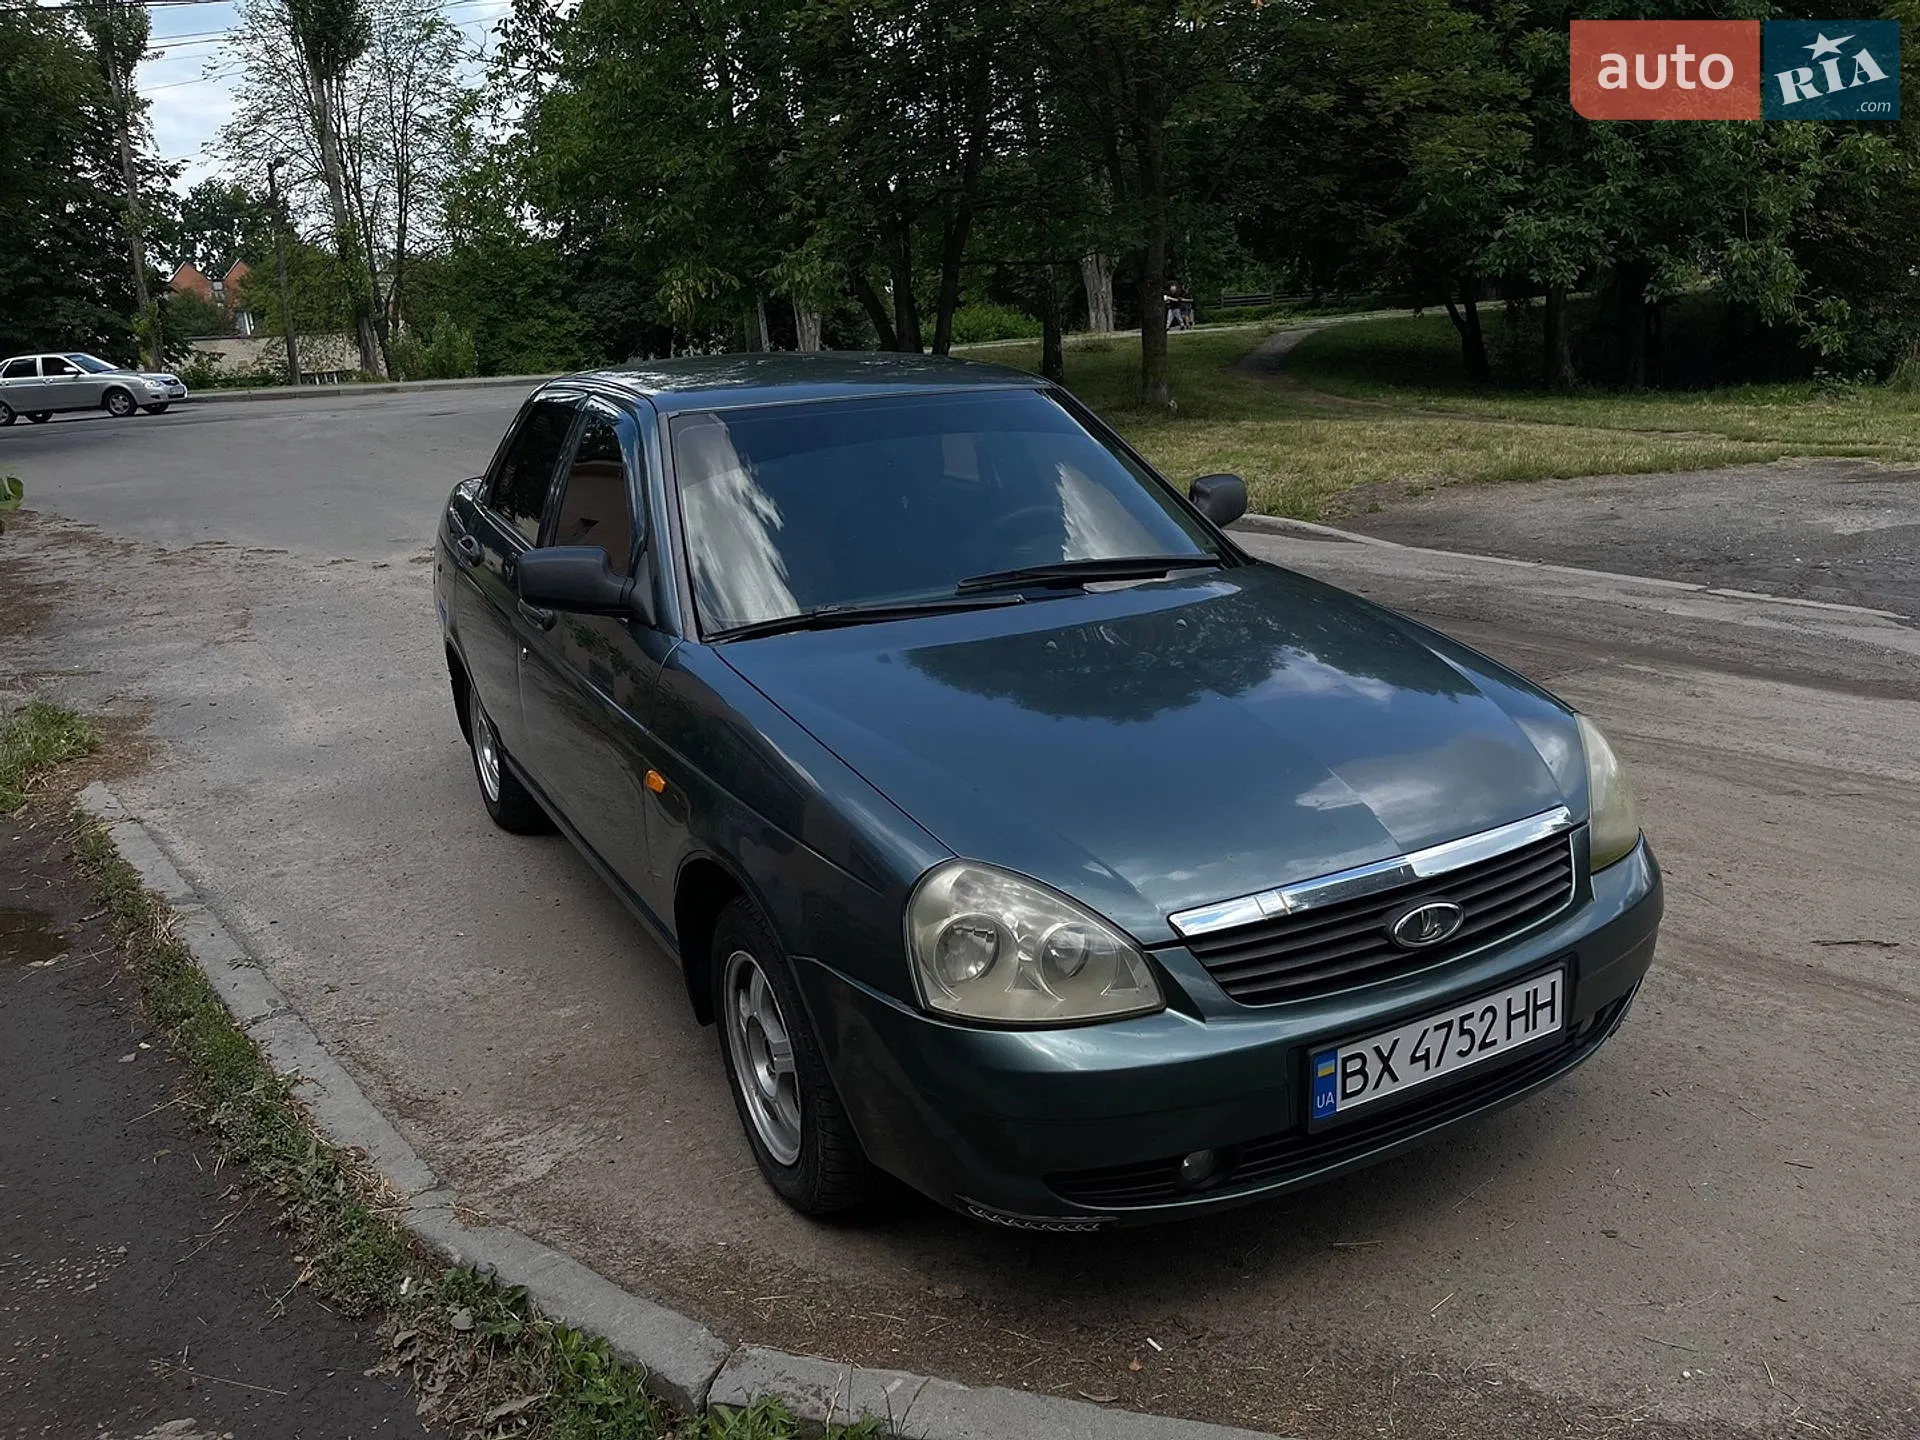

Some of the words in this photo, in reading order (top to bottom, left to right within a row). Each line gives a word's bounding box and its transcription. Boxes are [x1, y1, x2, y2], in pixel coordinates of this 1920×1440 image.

[1340, 1037, 1400, 1101] BX
[1409, 1005, 1498, 1072] 4752
[1506, 980, 1557, 1041] HH
[1316, 1091, 1335, 1109] UA
